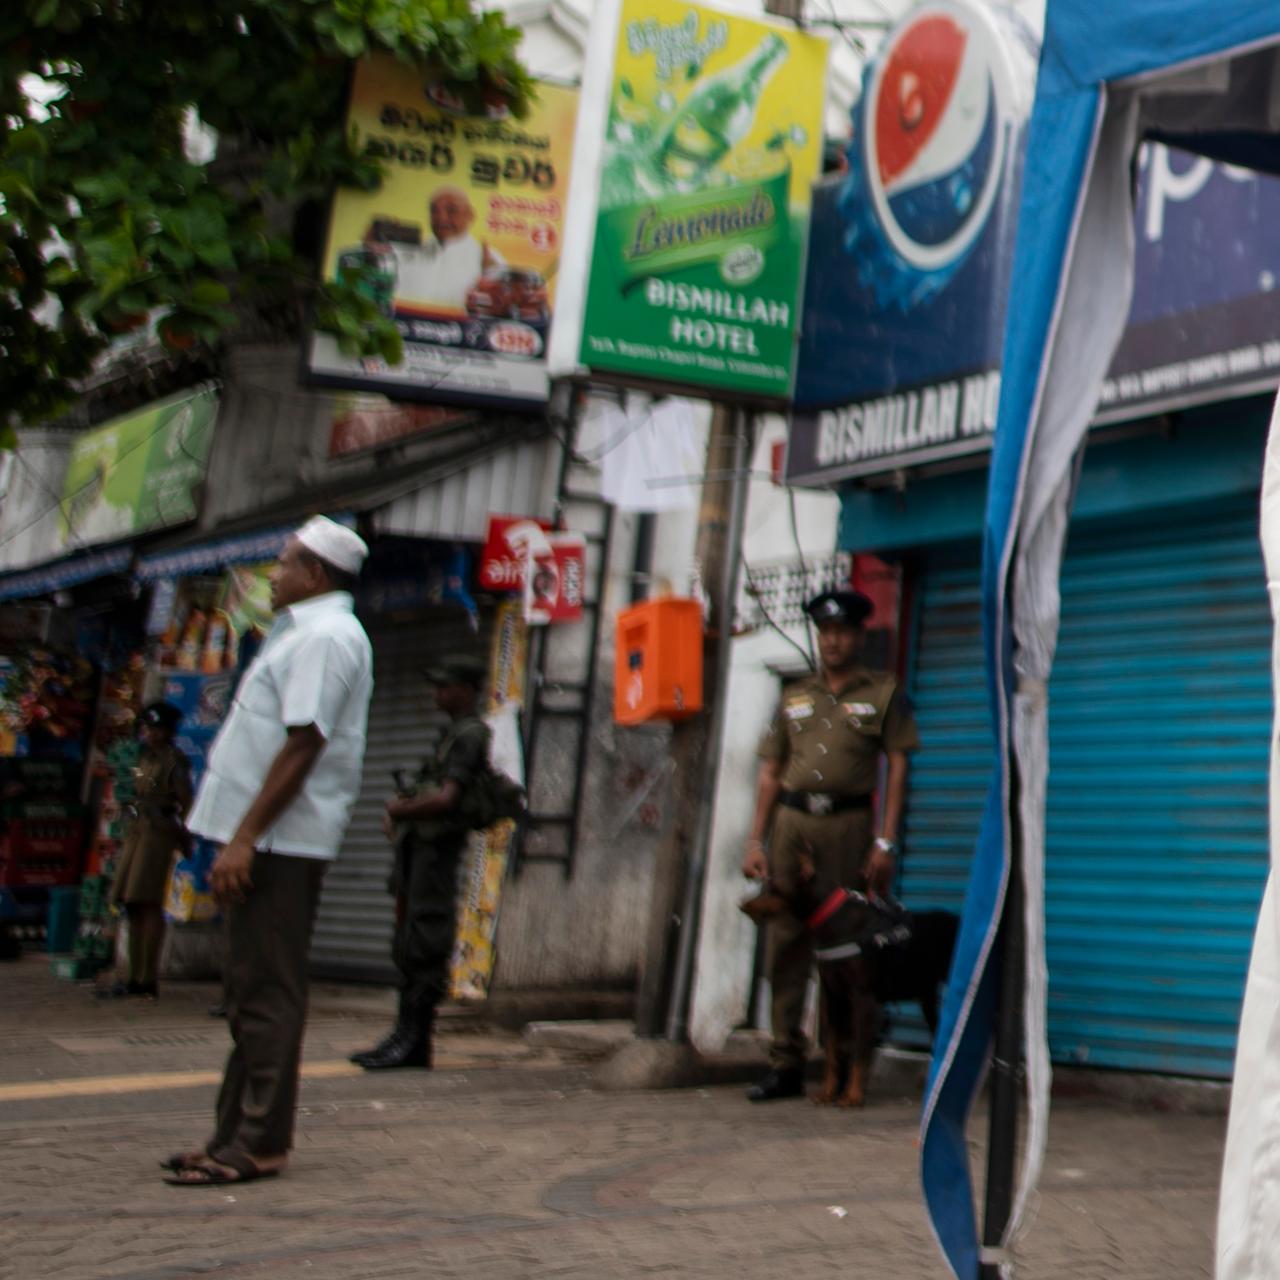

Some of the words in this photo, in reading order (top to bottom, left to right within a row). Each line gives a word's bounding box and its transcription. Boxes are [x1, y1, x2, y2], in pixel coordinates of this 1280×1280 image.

[623, 188, 776, 261] Lemonade
[645, 275, 791, 329] BISMILLAH
[669, 313, 760, 357] HOTEL
[815, 380, 958, 466] BISMILLAH
